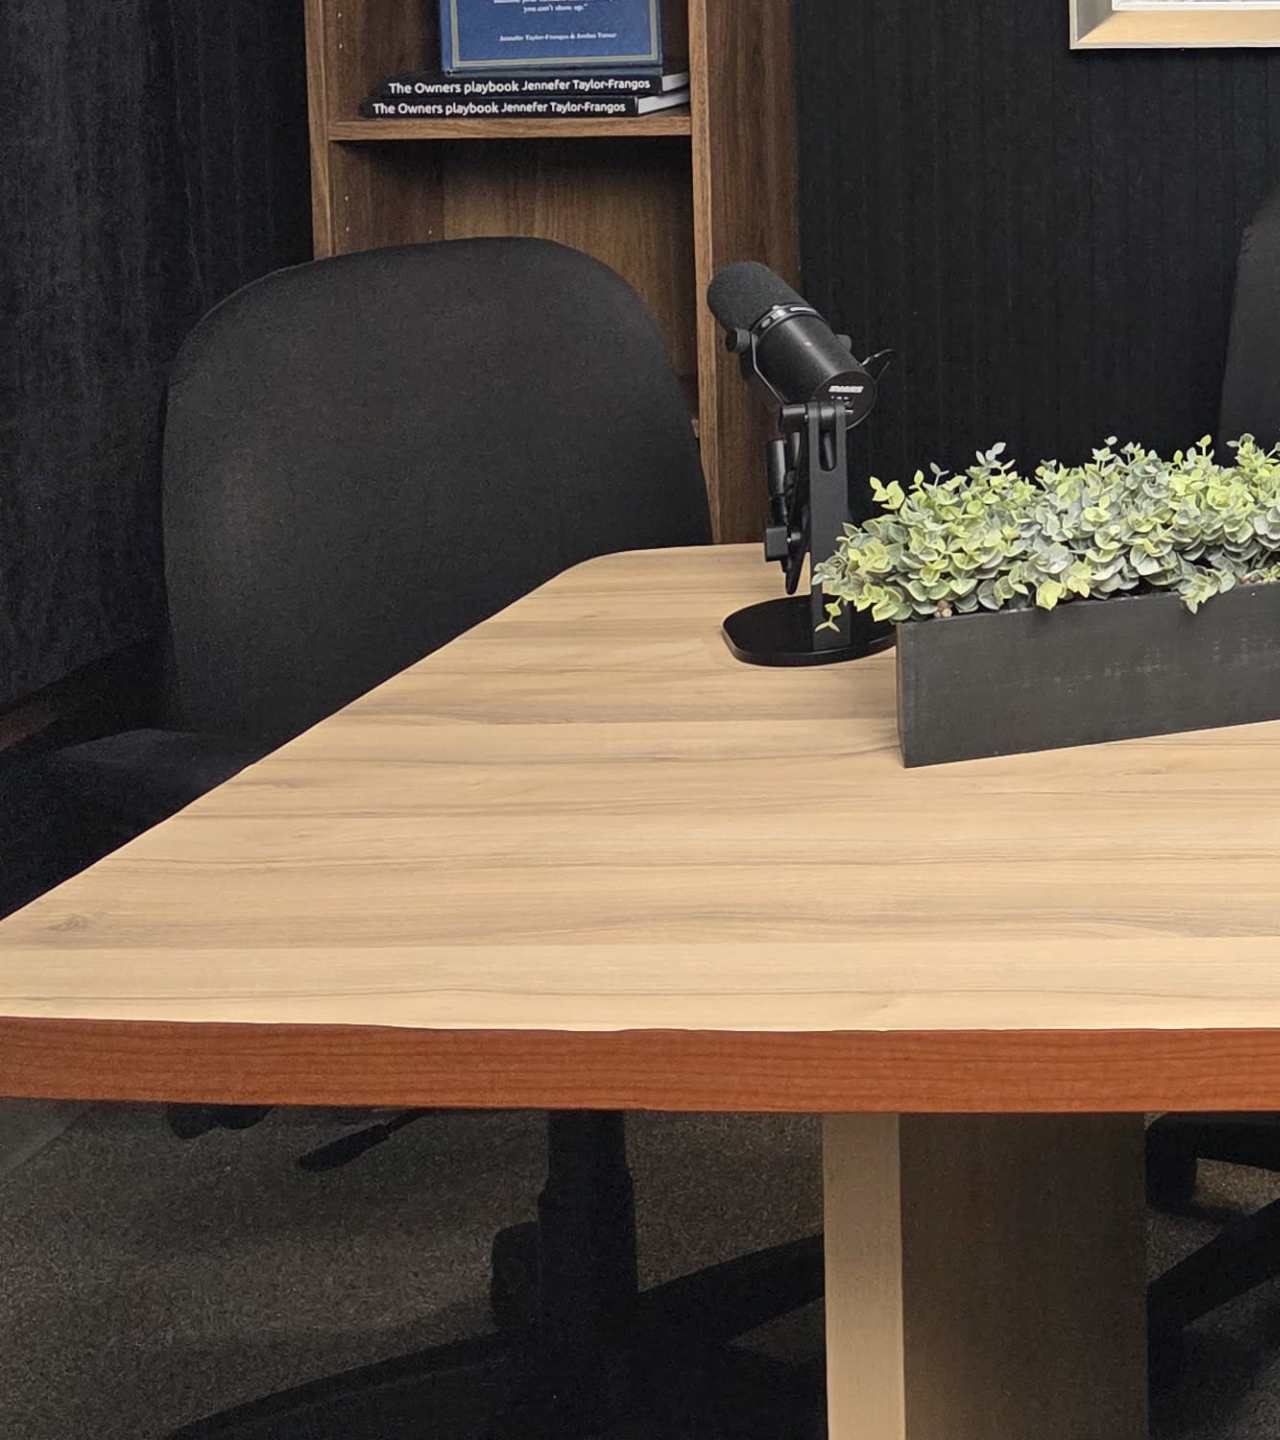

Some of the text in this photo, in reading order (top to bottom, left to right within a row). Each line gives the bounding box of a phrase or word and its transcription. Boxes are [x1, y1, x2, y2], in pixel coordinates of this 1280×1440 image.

[388, 78, 651, 95] The Owners playbook Jennefer Taylor-Frangos
[372, 101, 626, 116] The Owners playbook Jennefer Taylor-Frangos
